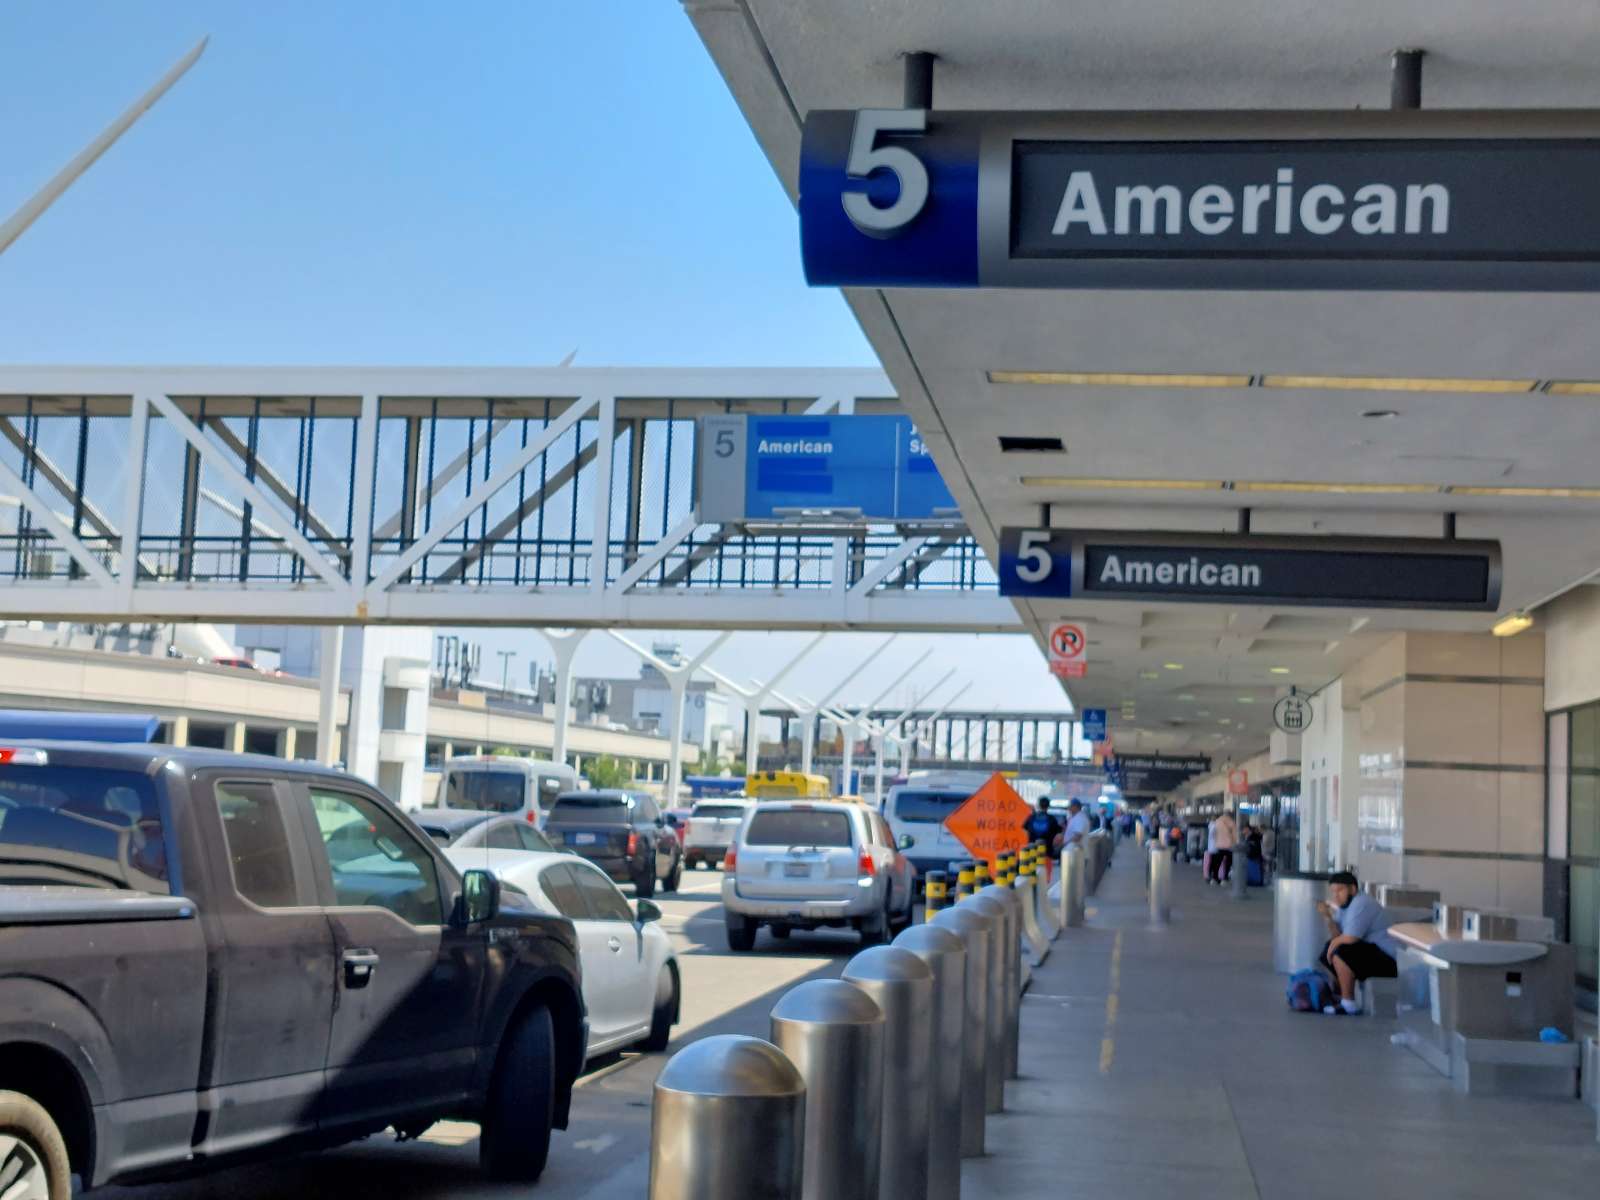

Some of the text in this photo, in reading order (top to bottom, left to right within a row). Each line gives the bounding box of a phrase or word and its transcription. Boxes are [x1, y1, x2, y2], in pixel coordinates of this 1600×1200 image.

[841, 108, 1451, 238] 5 American
[714, 430, 735, 458] 5
[757, 439, 833, 453] American
[1015, 531, 1262, 587] 5 American
[976, 800, 1017, 813] ROAD
[975, 816, 1017, 831] WORK
[972, 838, 1020, 850] AHEAD
